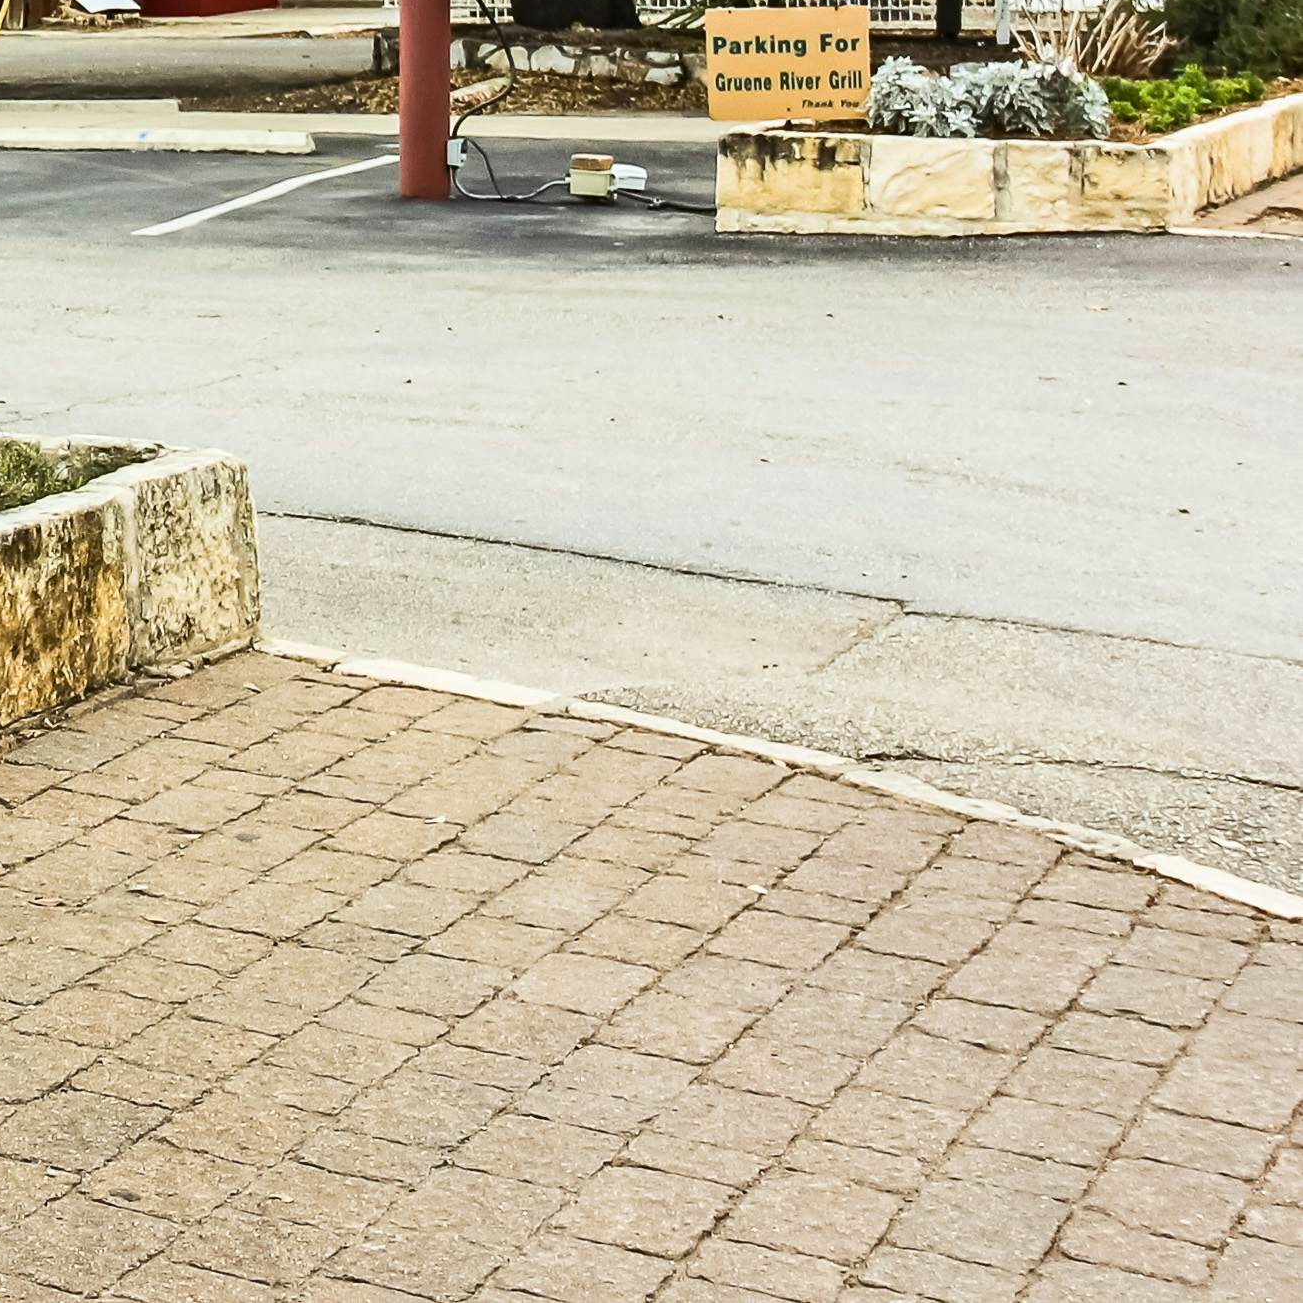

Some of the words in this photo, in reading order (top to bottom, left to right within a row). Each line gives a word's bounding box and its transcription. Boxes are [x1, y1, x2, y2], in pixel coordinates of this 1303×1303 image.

[712, 34, 807, 58] Parking
[820, 33, 860, 53] For
[715, 72, 773, 92] Gruene
[780, 71, 822, 91] River
[829, 69, 863, 90] Grill
[802, 99, 834, 109] Thank
[840, 99, 860, 109] You
